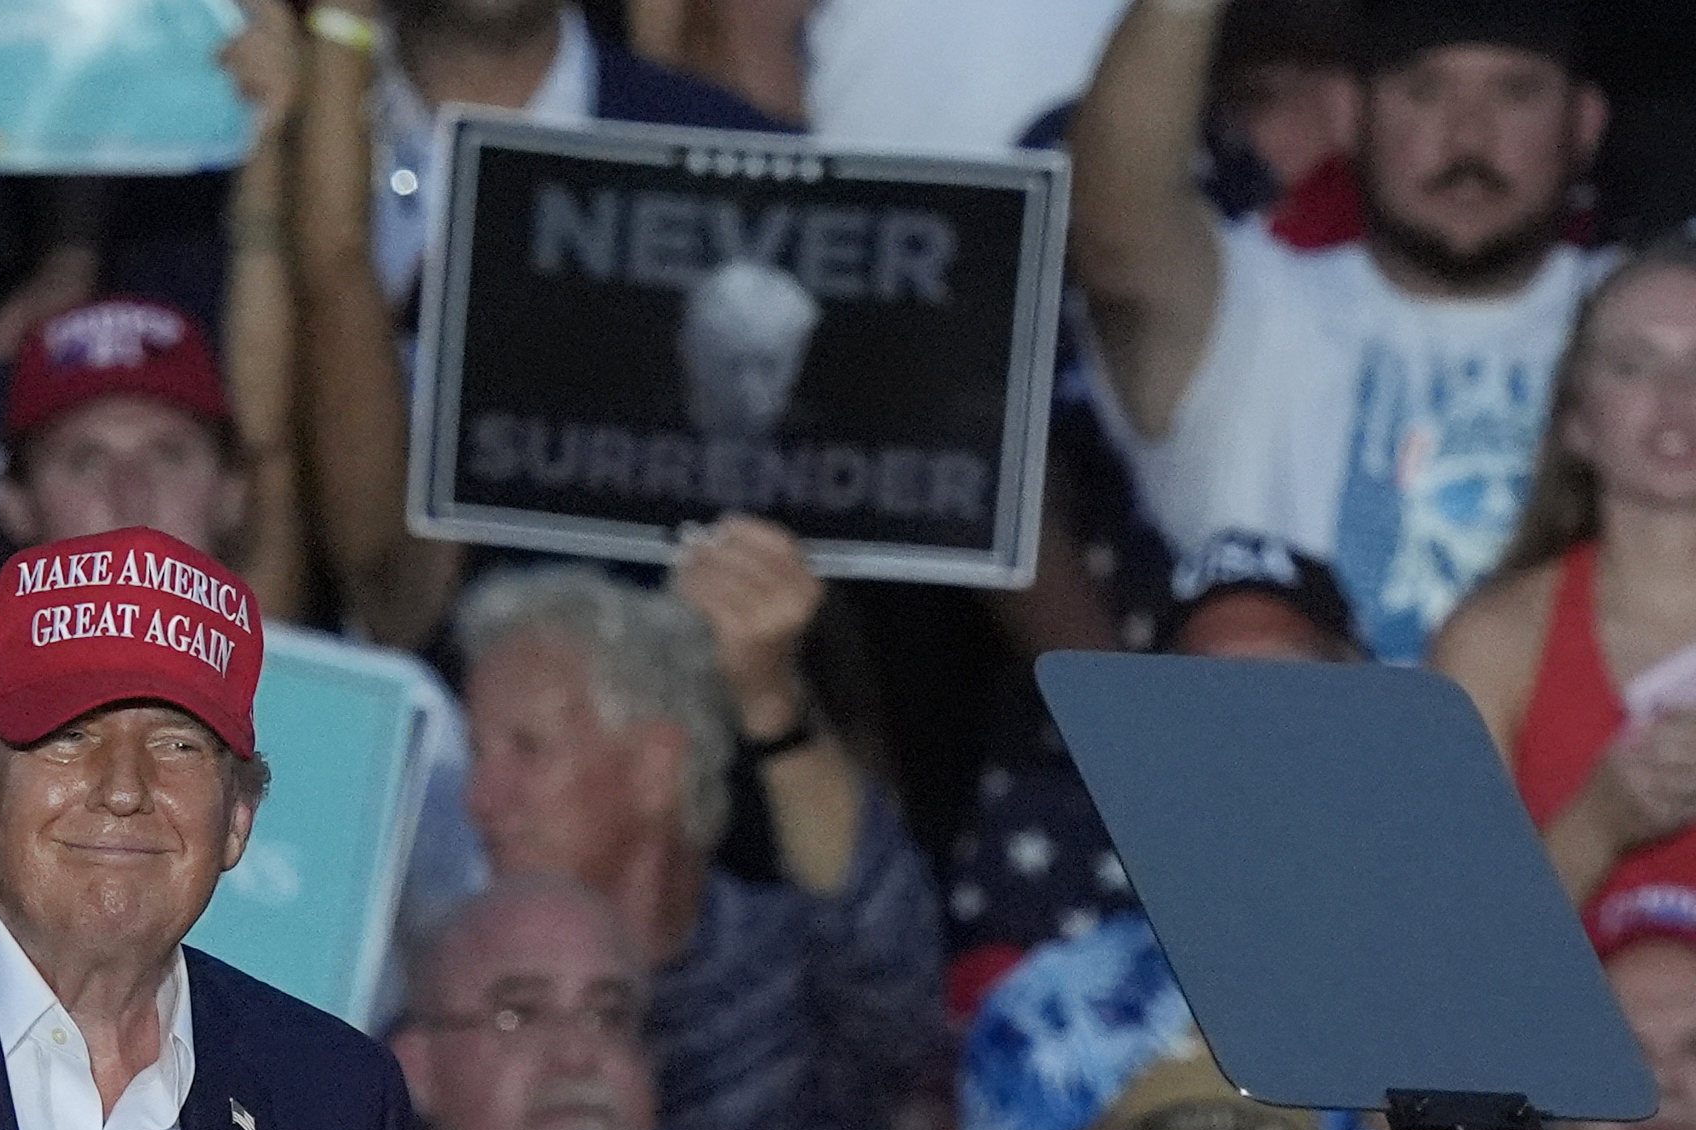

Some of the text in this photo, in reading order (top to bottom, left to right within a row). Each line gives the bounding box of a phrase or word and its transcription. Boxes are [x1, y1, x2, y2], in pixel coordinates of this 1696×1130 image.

[532, 181, 959, 302] NEVER
[470, 412, 992, 520] SURRENDER
[15, 549, 252, 635] MAKE AMERICA
[31, 601, 236, 679] GREAT AGAIN
